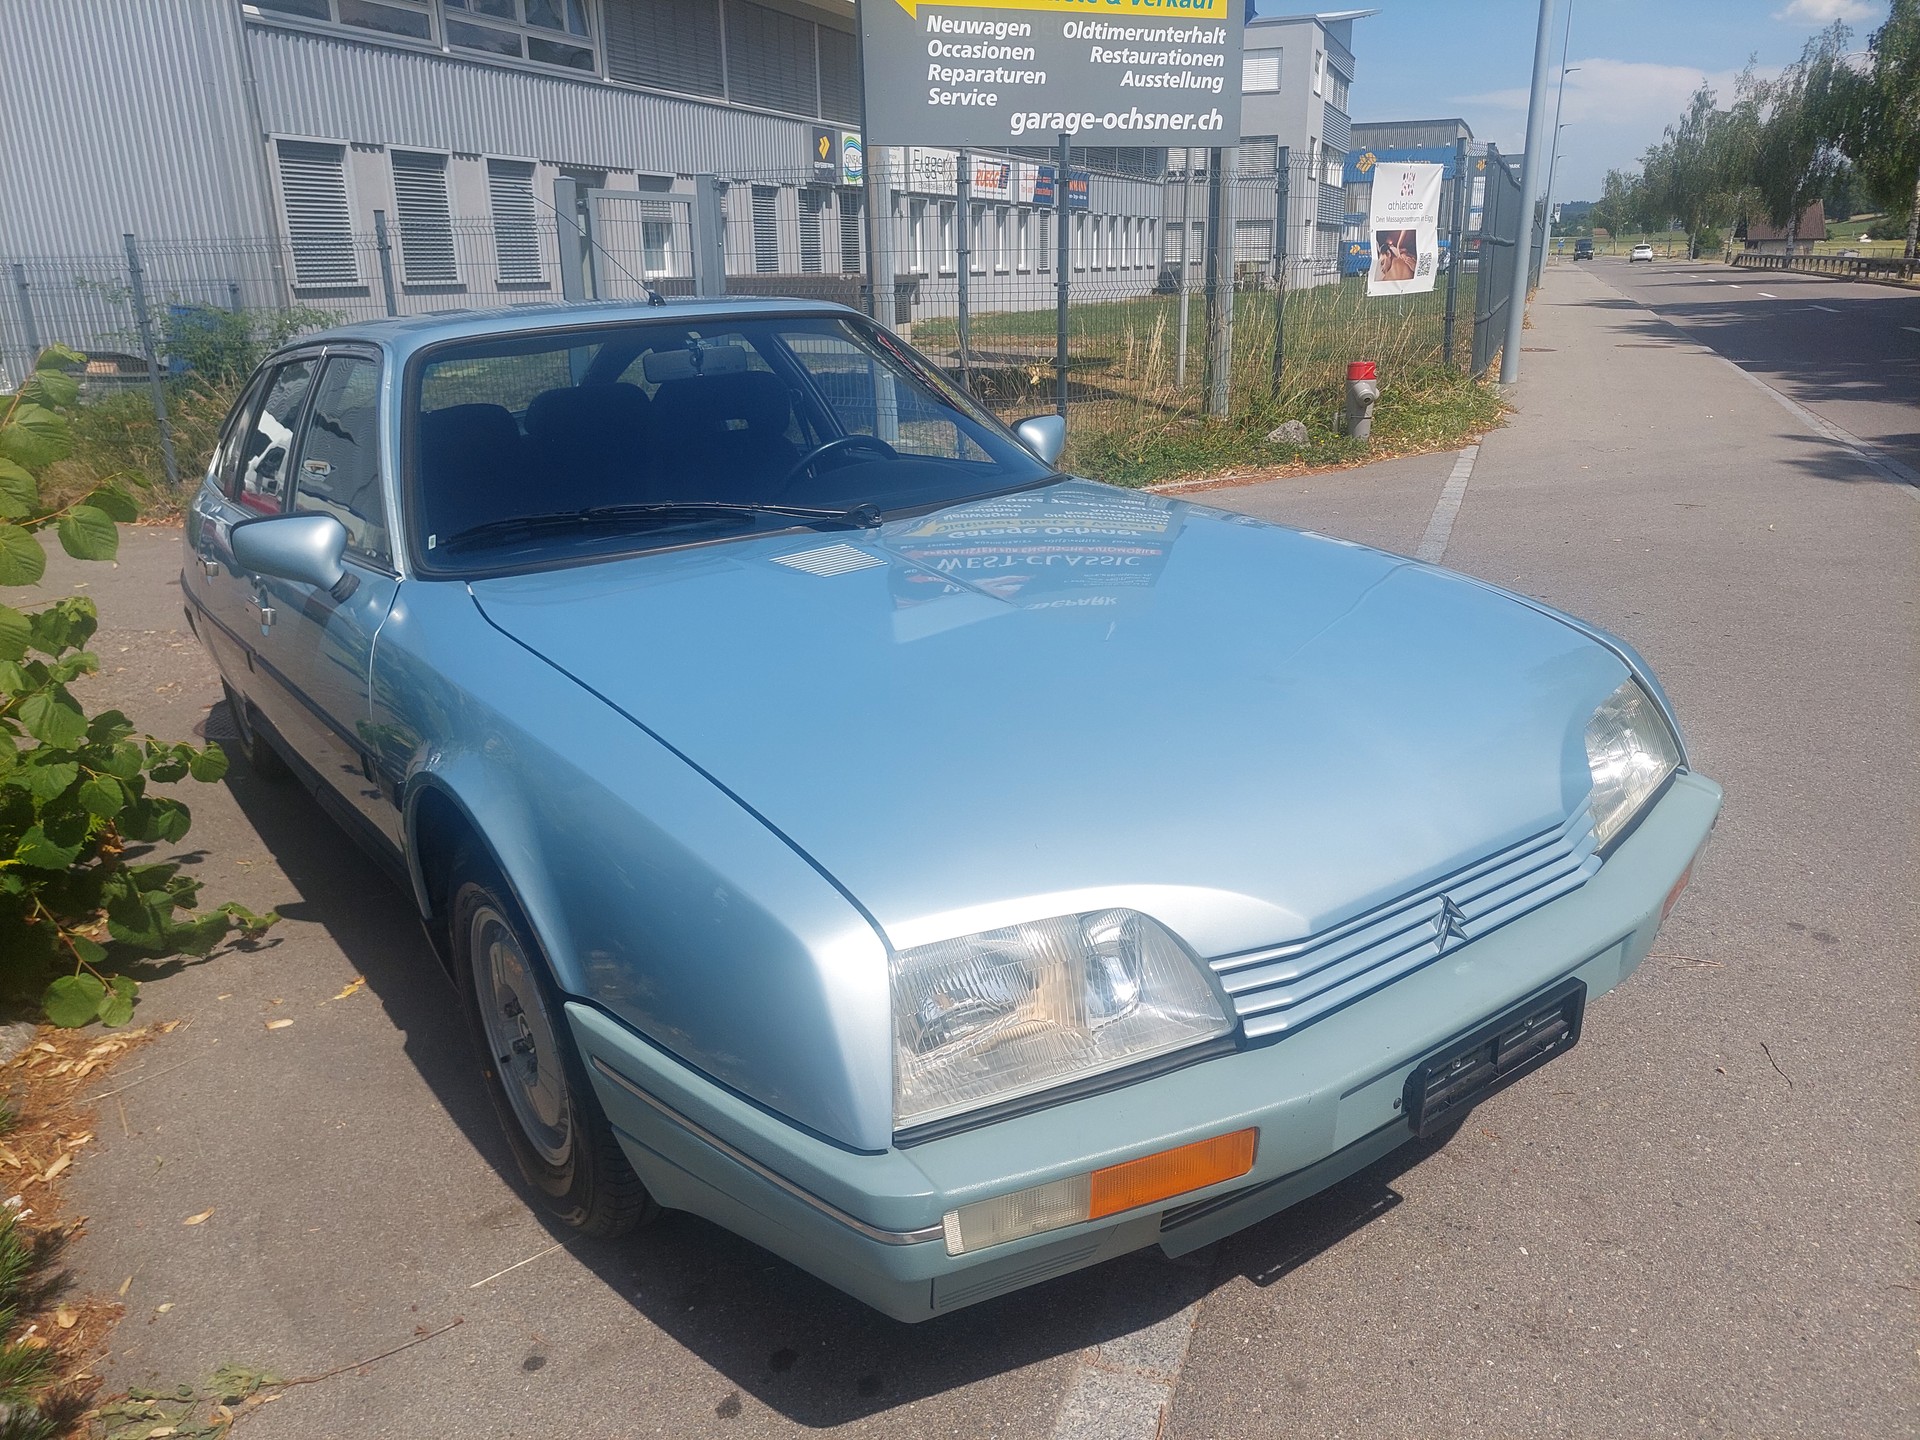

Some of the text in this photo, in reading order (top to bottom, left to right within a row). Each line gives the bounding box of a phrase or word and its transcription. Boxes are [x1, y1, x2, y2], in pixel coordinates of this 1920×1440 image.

[926, 15, 1031, 40] Neuwagen
[1063, 21, 1227, 44] Oldtimerunterhalt
[927, 39, 1036, 61] Occasionen
[1089, 46, 1225, 67] Restaurationen
[927, 63, 1047, 86] Reparaturen
[1119, 70, 1225, 93] Ausstellung
[927, 87, 998, 106] Service
[1010, 106, 1224, 135] garage-ochsner.ch
[1387, 200, 1424, 211] athleticare
